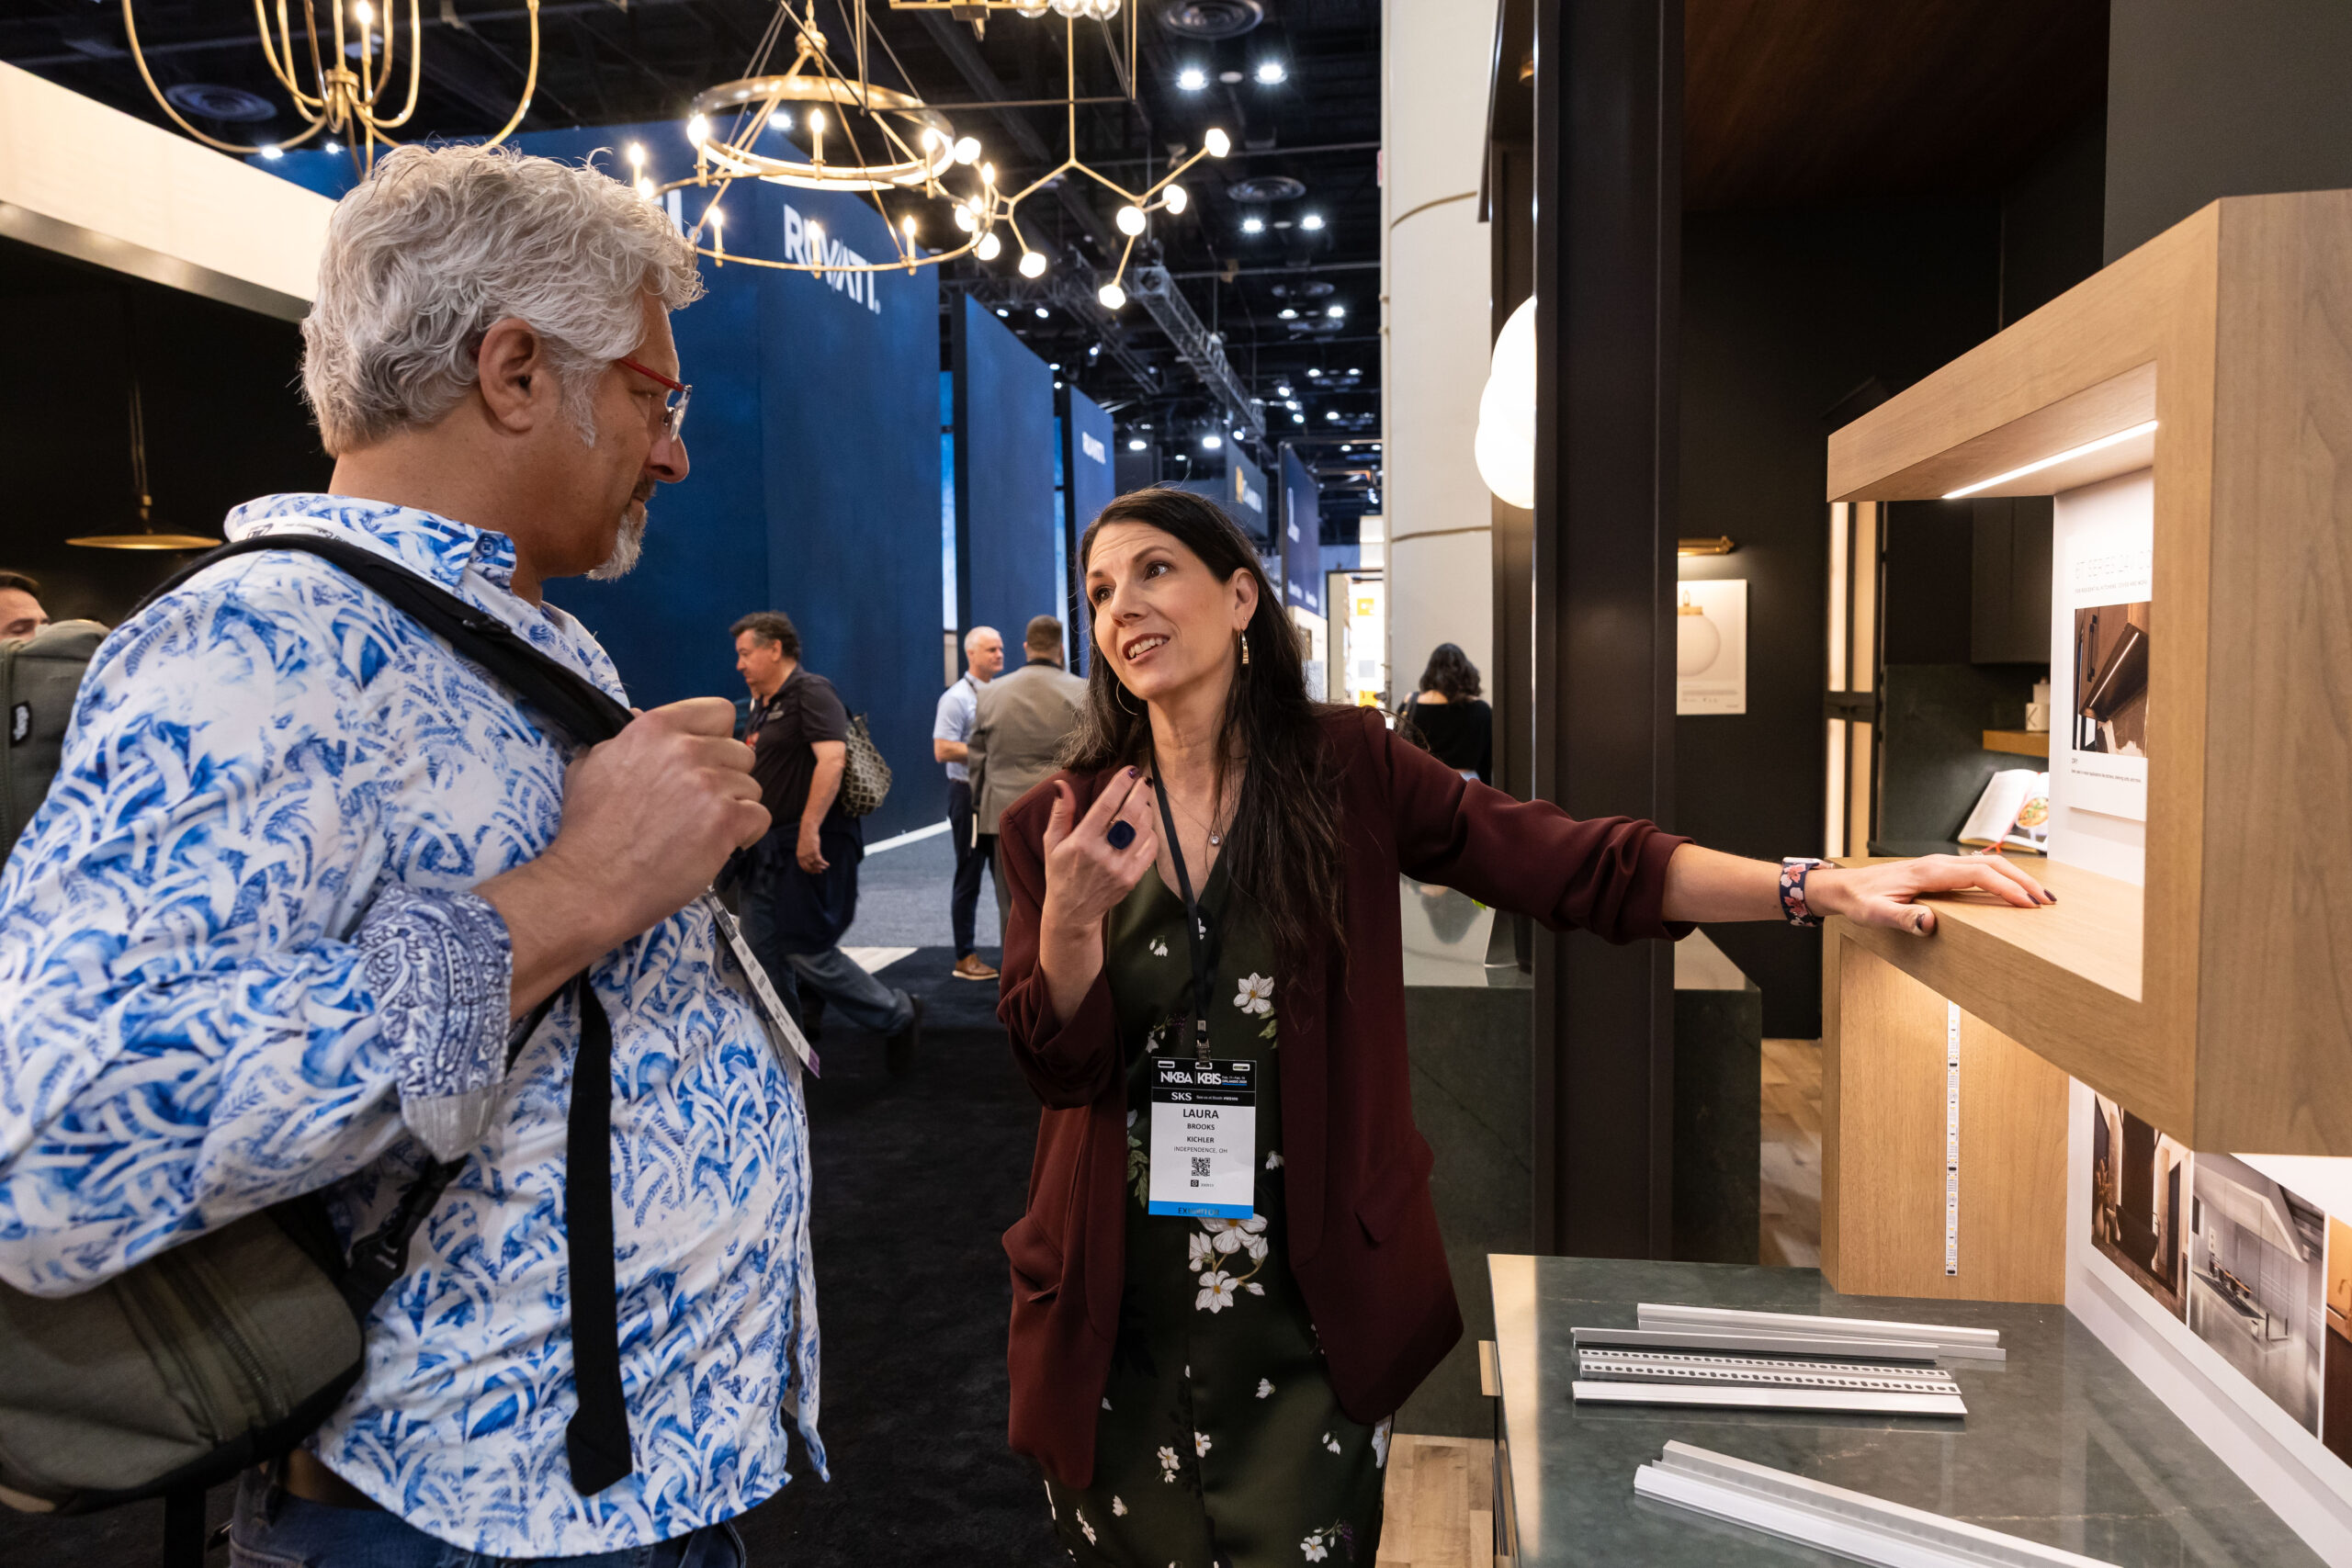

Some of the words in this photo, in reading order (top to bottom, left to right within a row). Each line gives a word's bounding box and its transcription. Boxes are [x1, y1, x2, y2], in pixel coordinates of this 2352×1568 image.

[1160, 1071, 1193, 1083] NKBA
[1197, 1072, 1222, 1085] KBIS
[1171, 1092, 1192, 1100] SKS
[1183, 1109, 1219, 1119] LAURA
